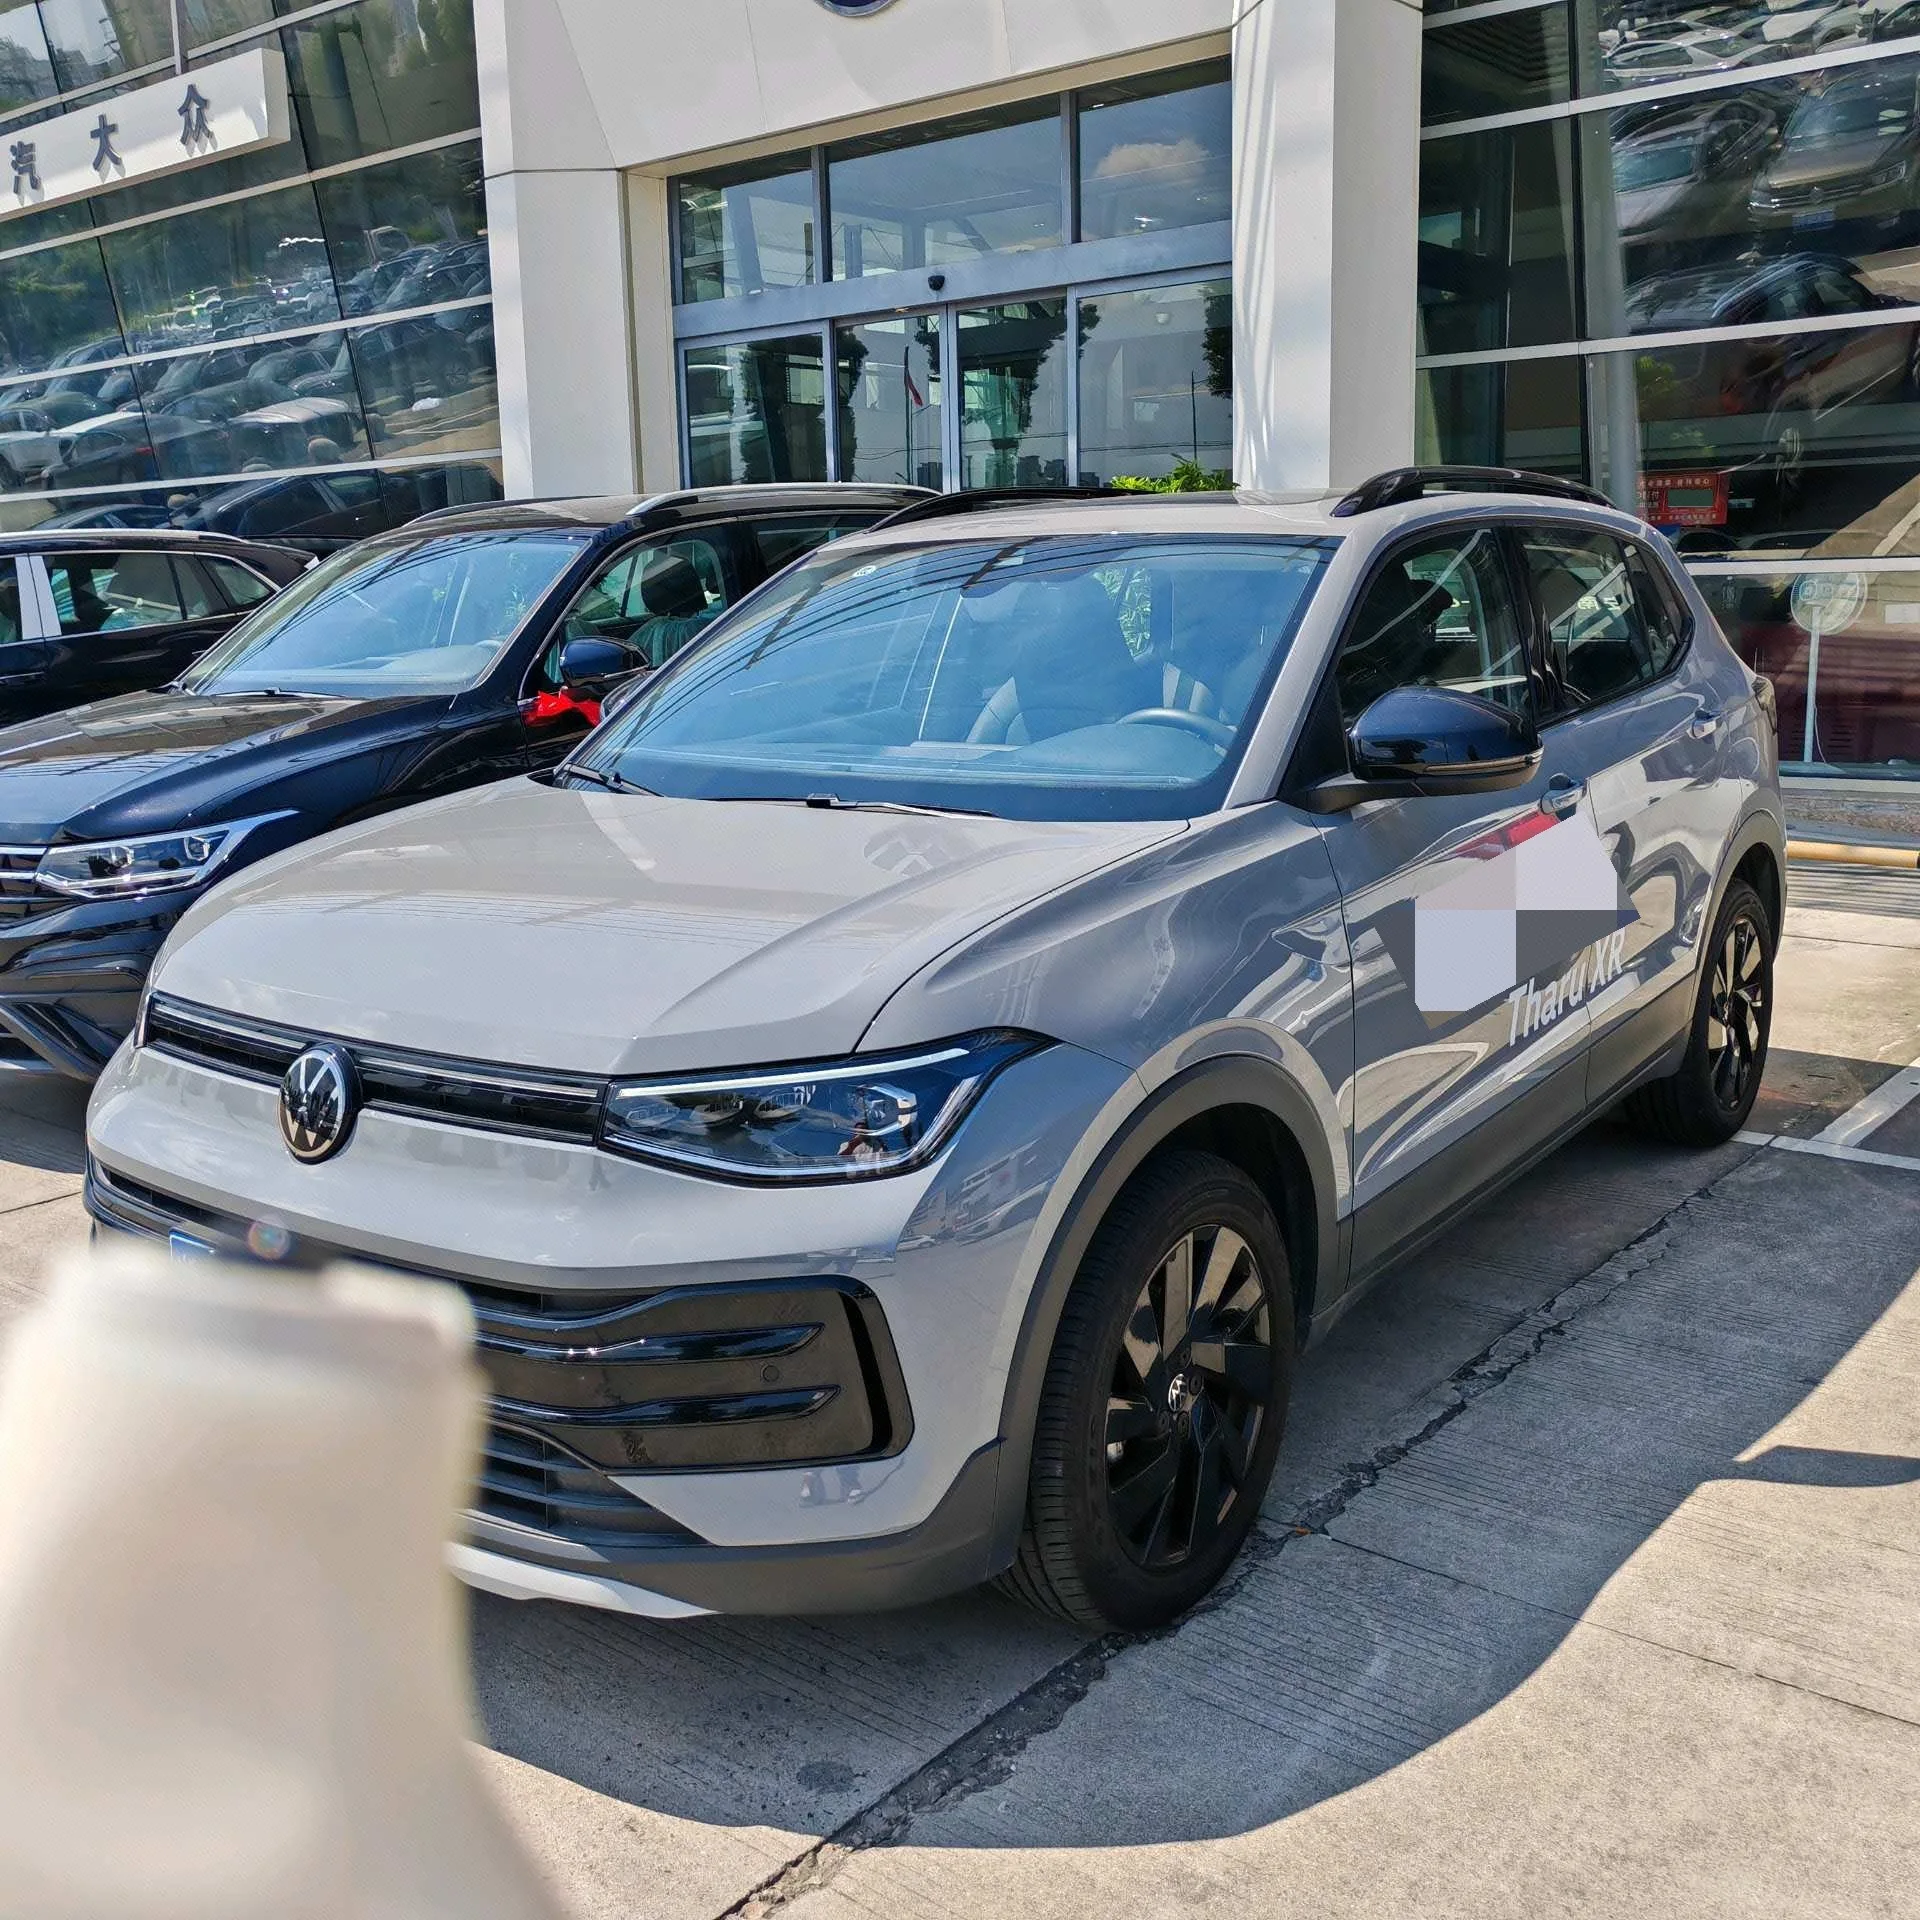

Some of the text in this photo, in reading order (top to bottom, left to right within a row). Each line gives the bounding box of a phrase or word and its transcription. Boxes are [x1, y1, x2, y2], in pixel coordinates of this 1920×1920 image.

[9, 83, 215, 196] 汽大众
[1504, 927, 1626, 1048] Tharu XR
